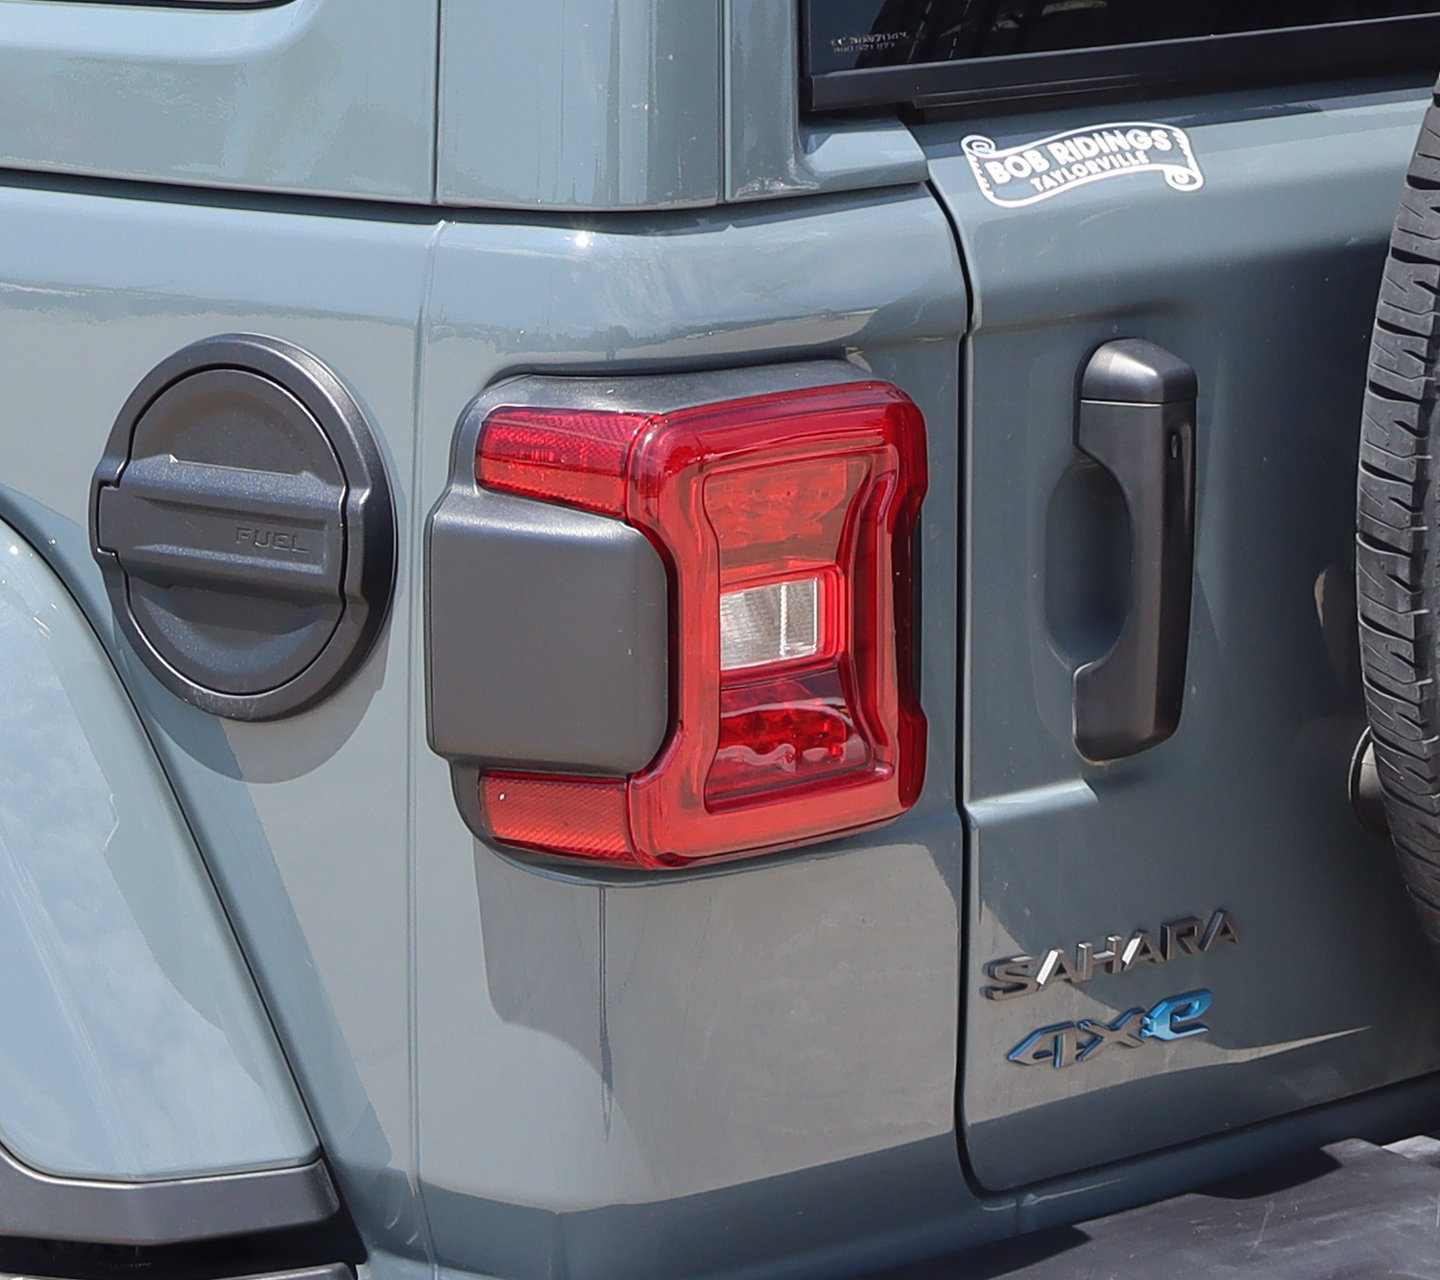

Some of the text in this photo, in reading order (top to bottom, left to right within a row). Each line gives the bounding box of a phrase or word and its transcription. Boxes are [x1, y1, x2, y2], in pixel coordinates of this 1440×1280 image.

[984, 129, 1172, 185] BOB RIDINGS
[1029, 150, 1151, 192] TAYLORVILLE
[236, 527, 310, 553] FUEL
[979, 908, 1241, 1001] SAHARA
